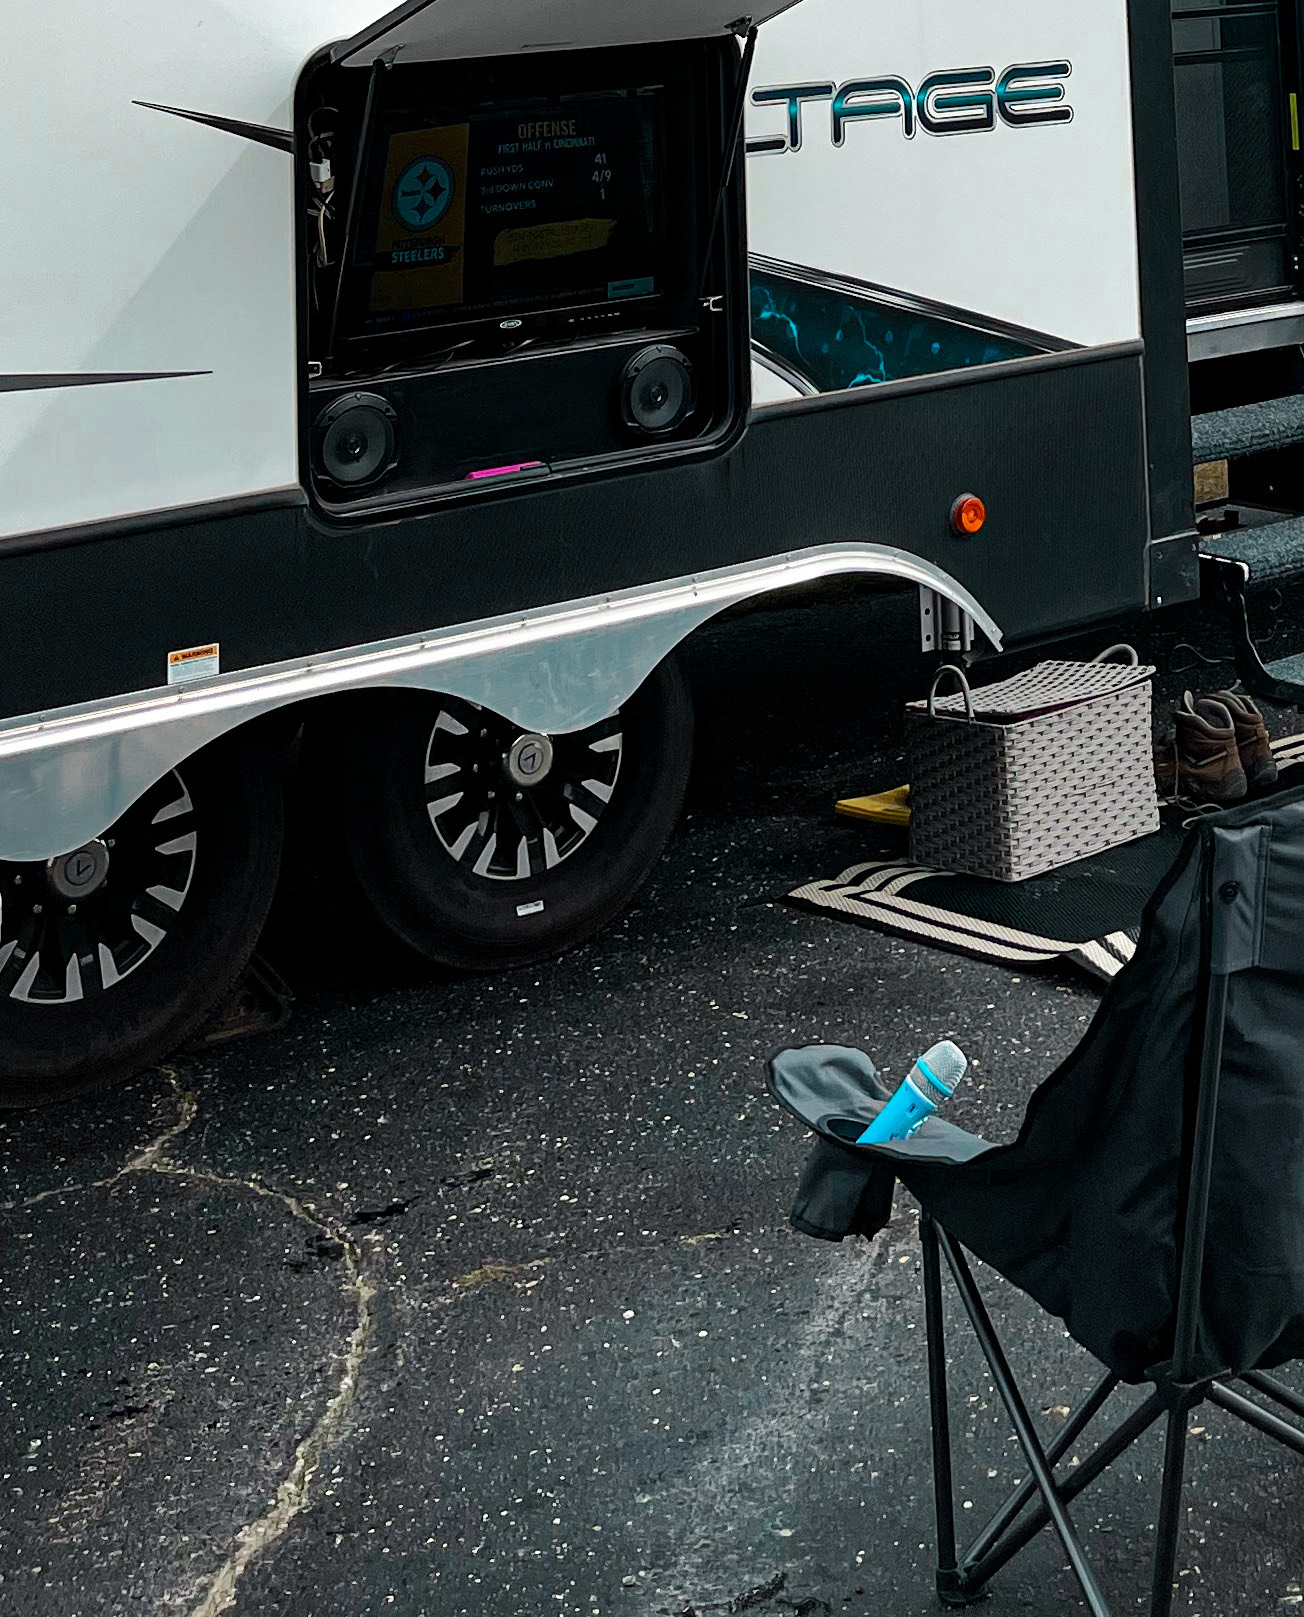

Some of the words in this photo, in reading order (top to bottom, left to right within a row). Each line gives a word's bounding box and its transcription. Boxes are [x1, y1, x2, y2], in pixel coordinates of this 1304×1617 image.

[518, 119, 577, 139] OFFENSE
[497, 143, 519, 155] FIRST
[522, 140, 543, 153] HALF
[594, 152, 607, 165] 41
[495, 182, 526, 193] DOWN
[527, 179, 554, 190] CONV
[592, 169, 612, 183] 4/9
[480, 199, 536, 214] TURNOVERS
[391, 247, 445, 264] STEELERS
